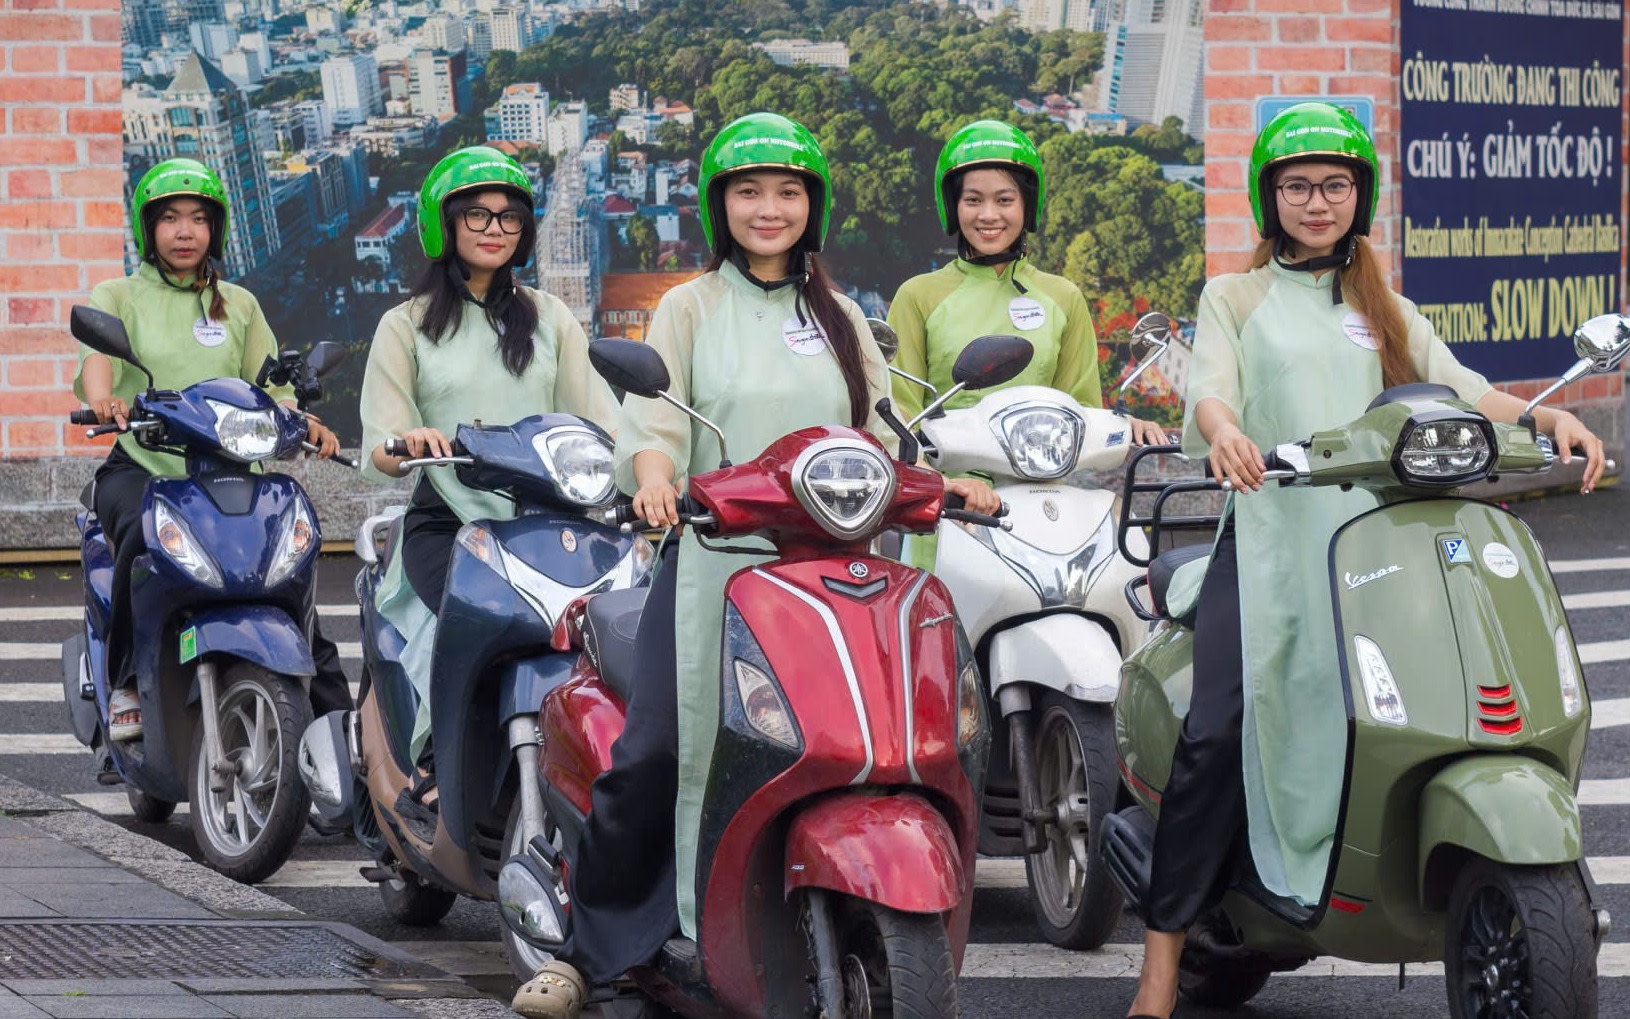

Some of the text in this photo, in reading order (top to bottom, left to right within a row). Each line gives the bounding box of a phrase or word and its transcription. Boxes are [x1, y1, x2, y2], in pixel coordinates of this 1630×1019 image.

[1402, 51, 1620, 108] CÔNG TRƯỜNG ĐANG THI CÔNG
[1406, 132, 1452, 178] CHÚ
[1456, 132, 1476, 179] Ý:
[1482, 120, 1532, 178] GIẢM
[1536, 121, 1574, 178] TỐC
[1576, 126, 1603, 187] ĐỘ
[1419, 303, 1488, 342] TENTION:
[1491, 278, 1545, 342] SLOW
[1548, 276, 1605, 339] DOWN
[1344, 564, 1404, 590] Vespa
